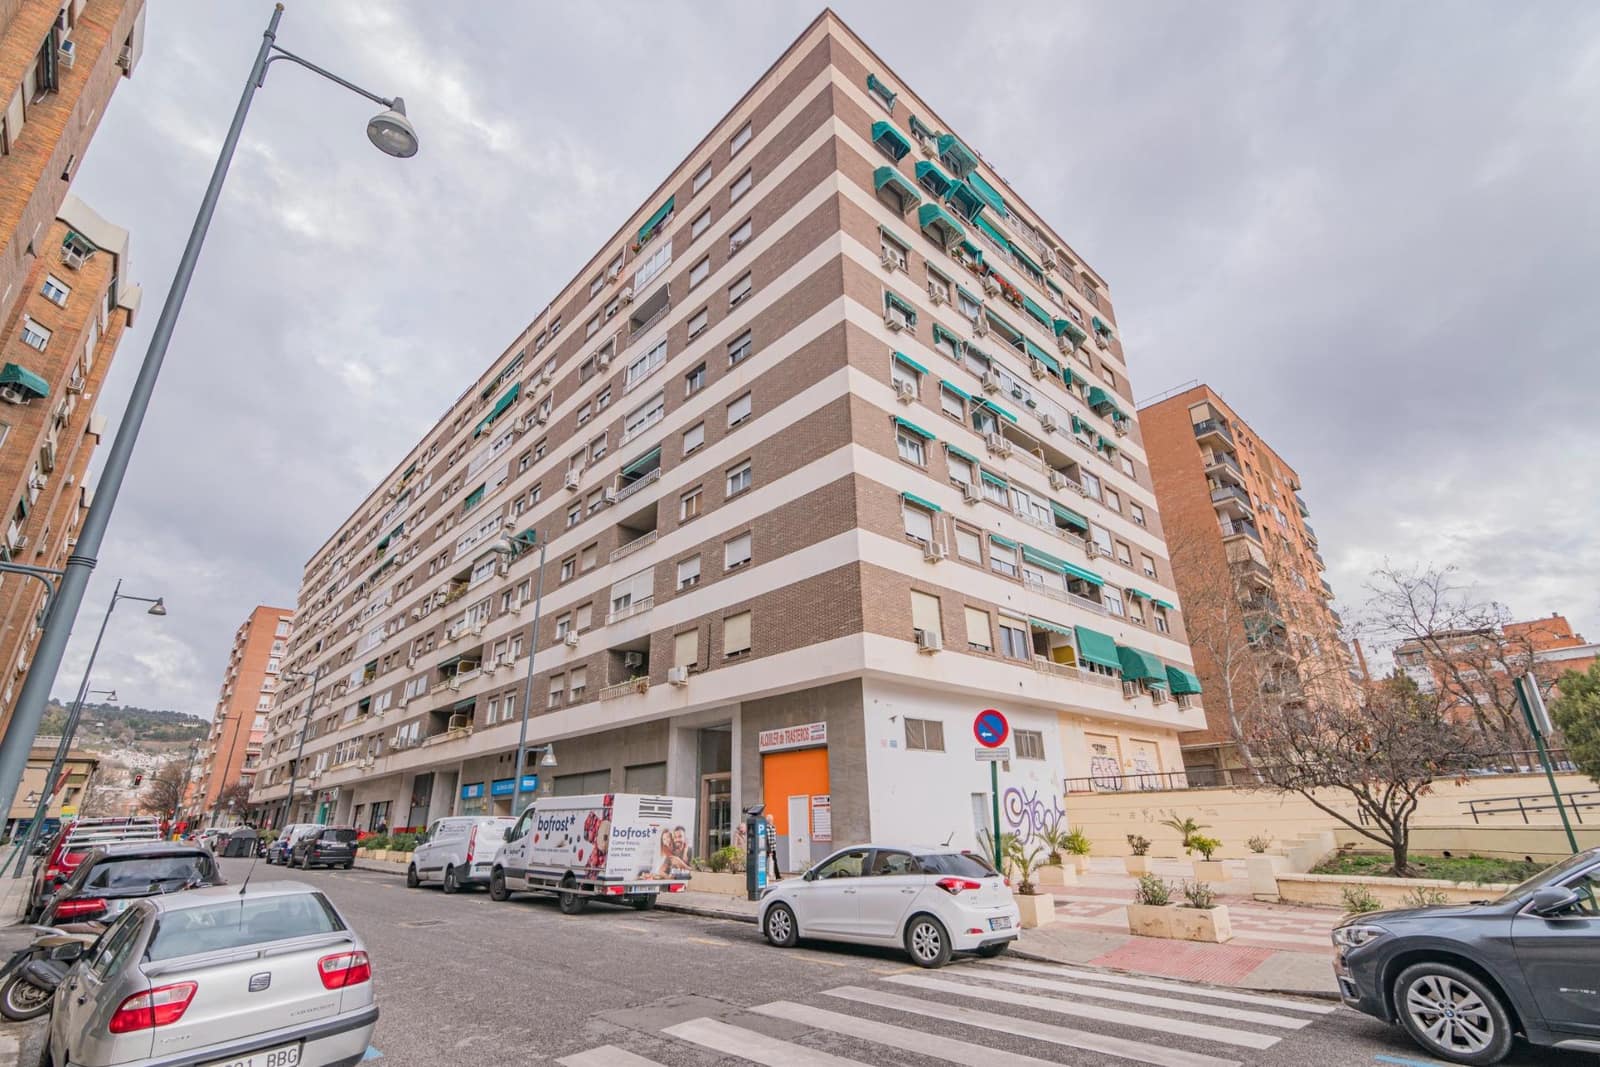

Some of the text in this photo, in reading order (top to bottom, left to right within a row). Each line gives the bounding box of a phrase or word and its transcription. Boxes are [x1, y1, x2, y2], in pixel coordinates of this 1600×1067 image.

[760, 731, 779, 747] ALQUILER
[785, 727, 809, 744] TRASTEROS
[758, 823, 765, 834] P
[266, 1048, 297, 1067] BBG
